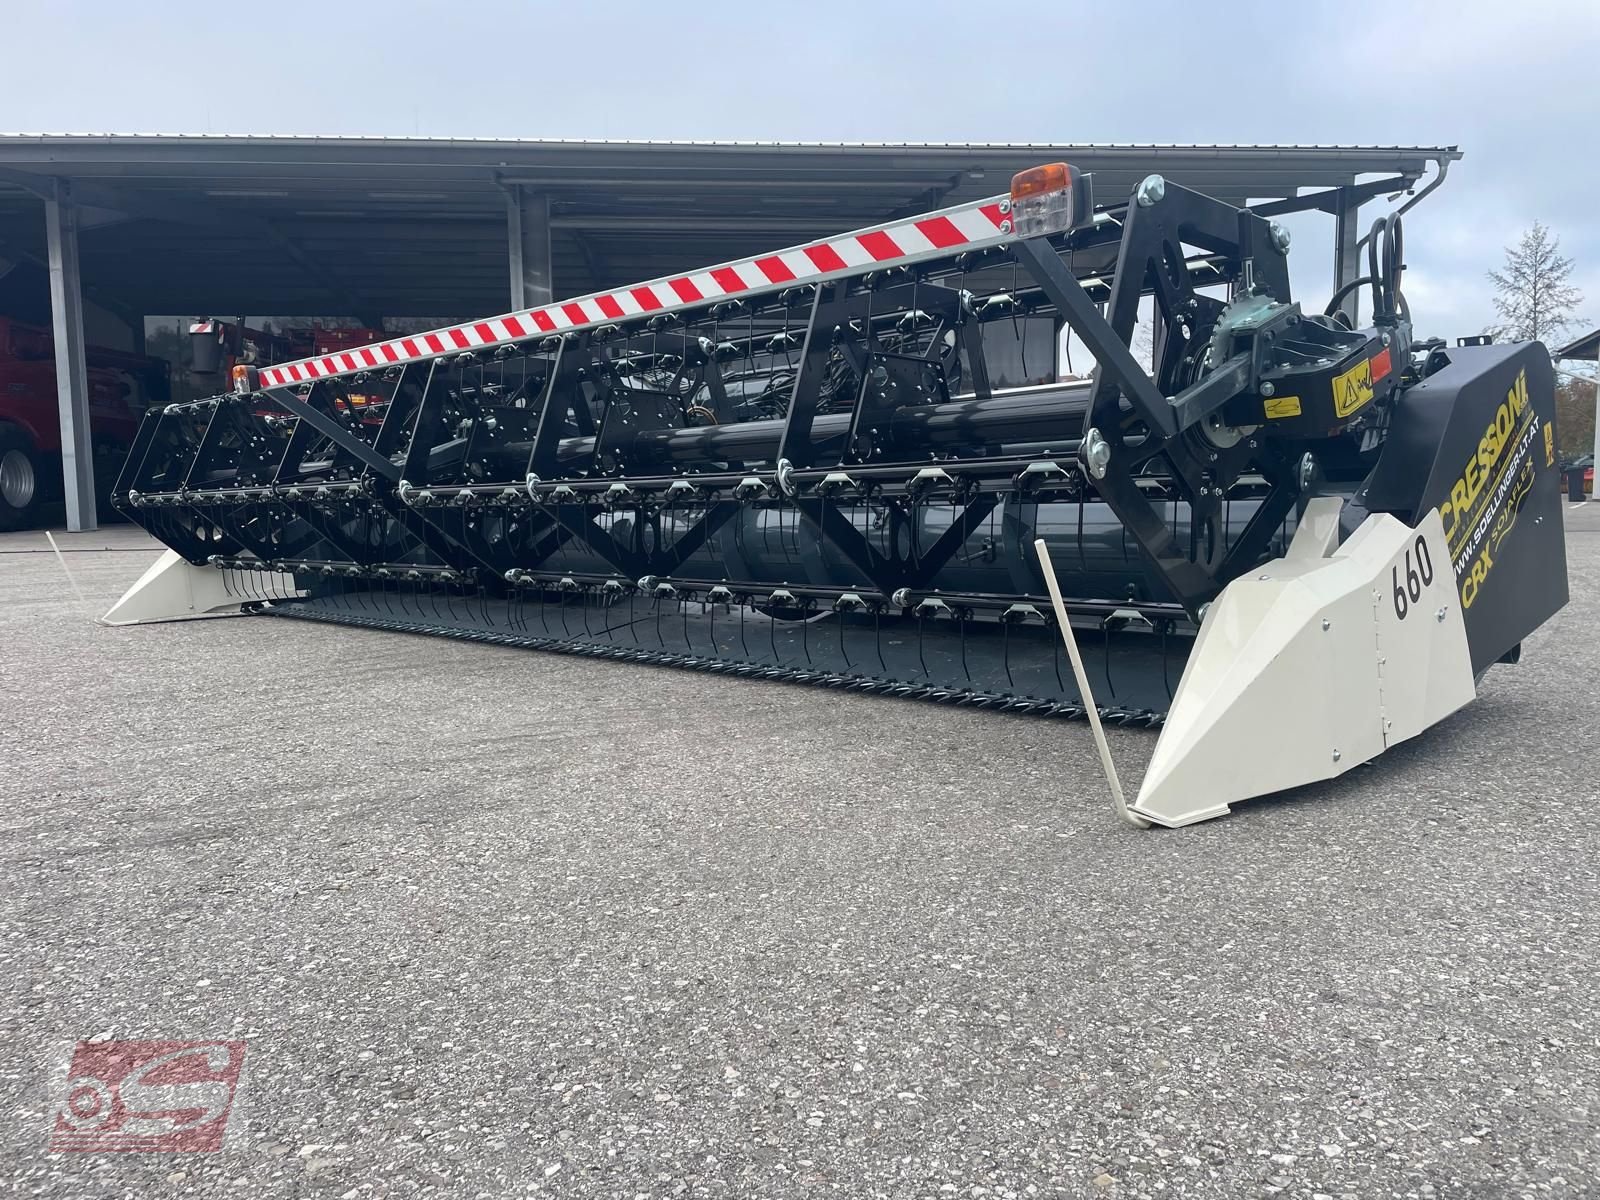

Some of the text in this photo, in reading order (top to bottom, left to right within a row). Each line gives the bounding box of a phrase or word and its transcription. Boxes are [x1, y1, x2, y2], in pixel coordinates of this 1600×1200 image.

[1454, 416, 1539, 577] WW.SOELLINGER-LT.AT
[1462, 540, 1493, 608] CRX
[1491, 456, 1533, 542] SOJAFLEX
[1392, 534, 1433, 620] 660
